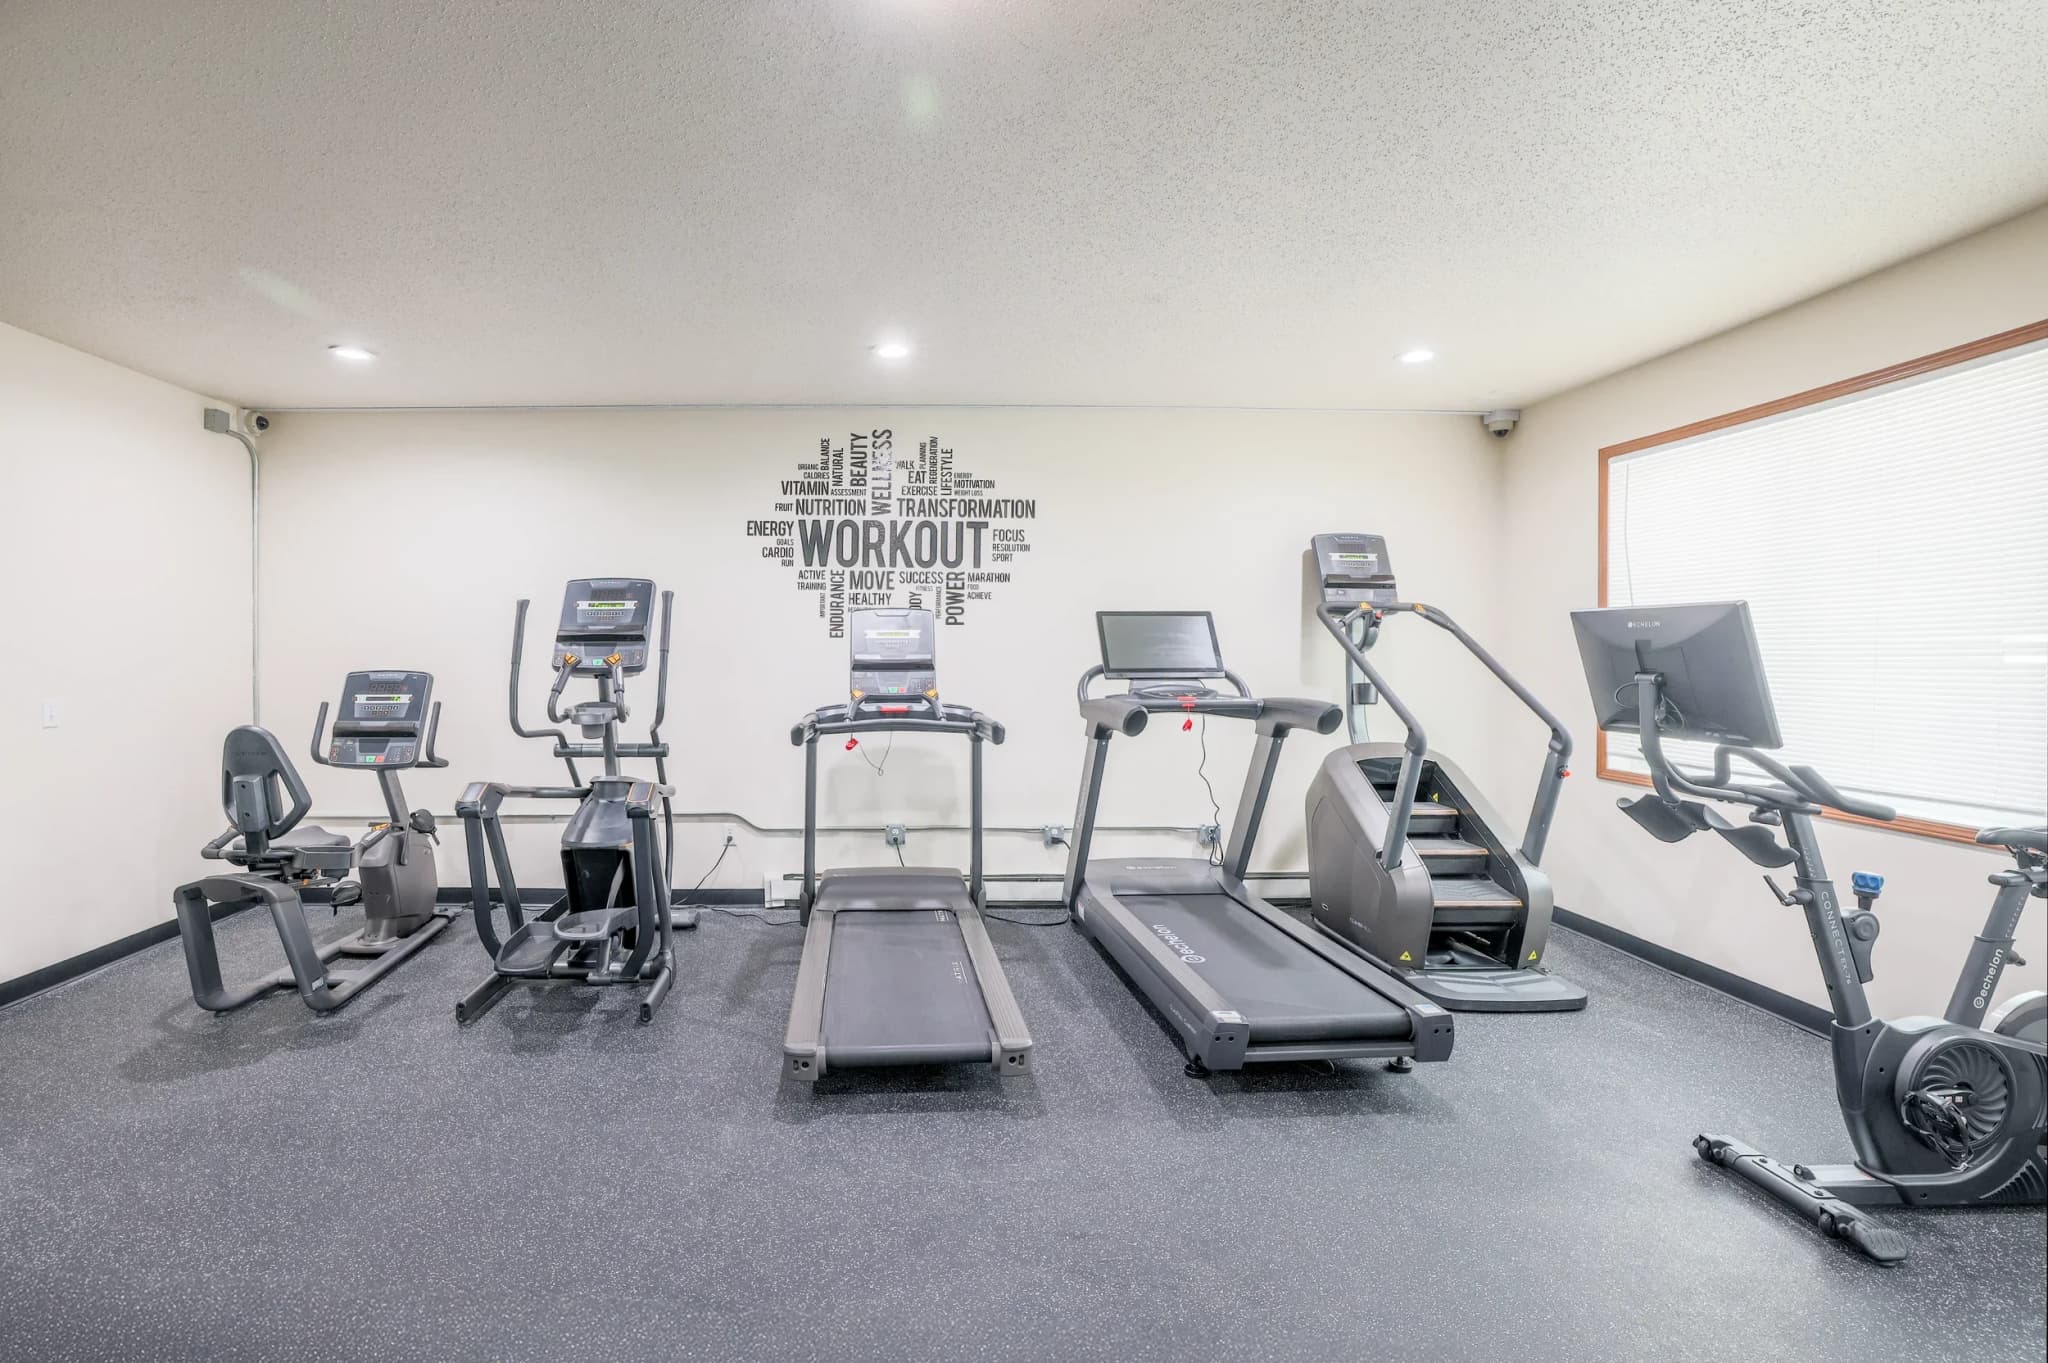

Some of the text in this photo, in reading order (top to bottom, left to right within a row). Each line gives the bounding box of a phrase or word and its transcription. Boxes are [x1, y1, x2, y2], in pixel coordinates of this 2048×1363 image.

[820, 438, 830, 471] BALANCE
[850, 433, 868, 486] BEAUTY
[929, 436, 938, 484] REGENERATION
[832, 447, 844, 487] NATURAL
[940, 448, 953, 496] LIFESTYLE
[908, 470, 927, 484] EAT
[953, 480, 996, 489] MOTIVATION
[781, 480, 829, 495] VITAMIN
[830, 488, 867, 496] ASSESSMENT
[901, 486, 938, 496] EXERCISE
[774, 503, 794, 512] FRUIT
[795, 499, 867, 516] NUTRITION
[896, 498, 1036, 518] TRANSFORMATION
[746, 520, 795, 536] ENERGY
[992, 528, 1025, 542] FOCUS
[798, 519, 989, 568] WORKOUT
[992, 543, 1031, 552] RESOLUTION
[762, 547, 794, 558] CARDIO
[991, 553, 1014, 562] SPORT
[781, 559, 794, 567] RUN
[798, 569, 826, 580] ACTIVE
[849, 570, 896, 590] MOVE
[898, 571, 944, 584] SUCCESS
[967, 573, 1011, 583] MARATHON
[797, 581, 827, 591] TRAINING
[848, 592, 892, 606] HEALTHY
[909, 591, 922, 610] ODY
[945, 571, 966, 626] POWER
[967, 591, 993, 600] ACHIEVE
[829, 569, 846, 639] ENDURANCE
[1821, 891, 1845, 956] CONNECT
[1152, 924, 1195, 955] echelon
[1979, 949, 2004, 998] echelon
